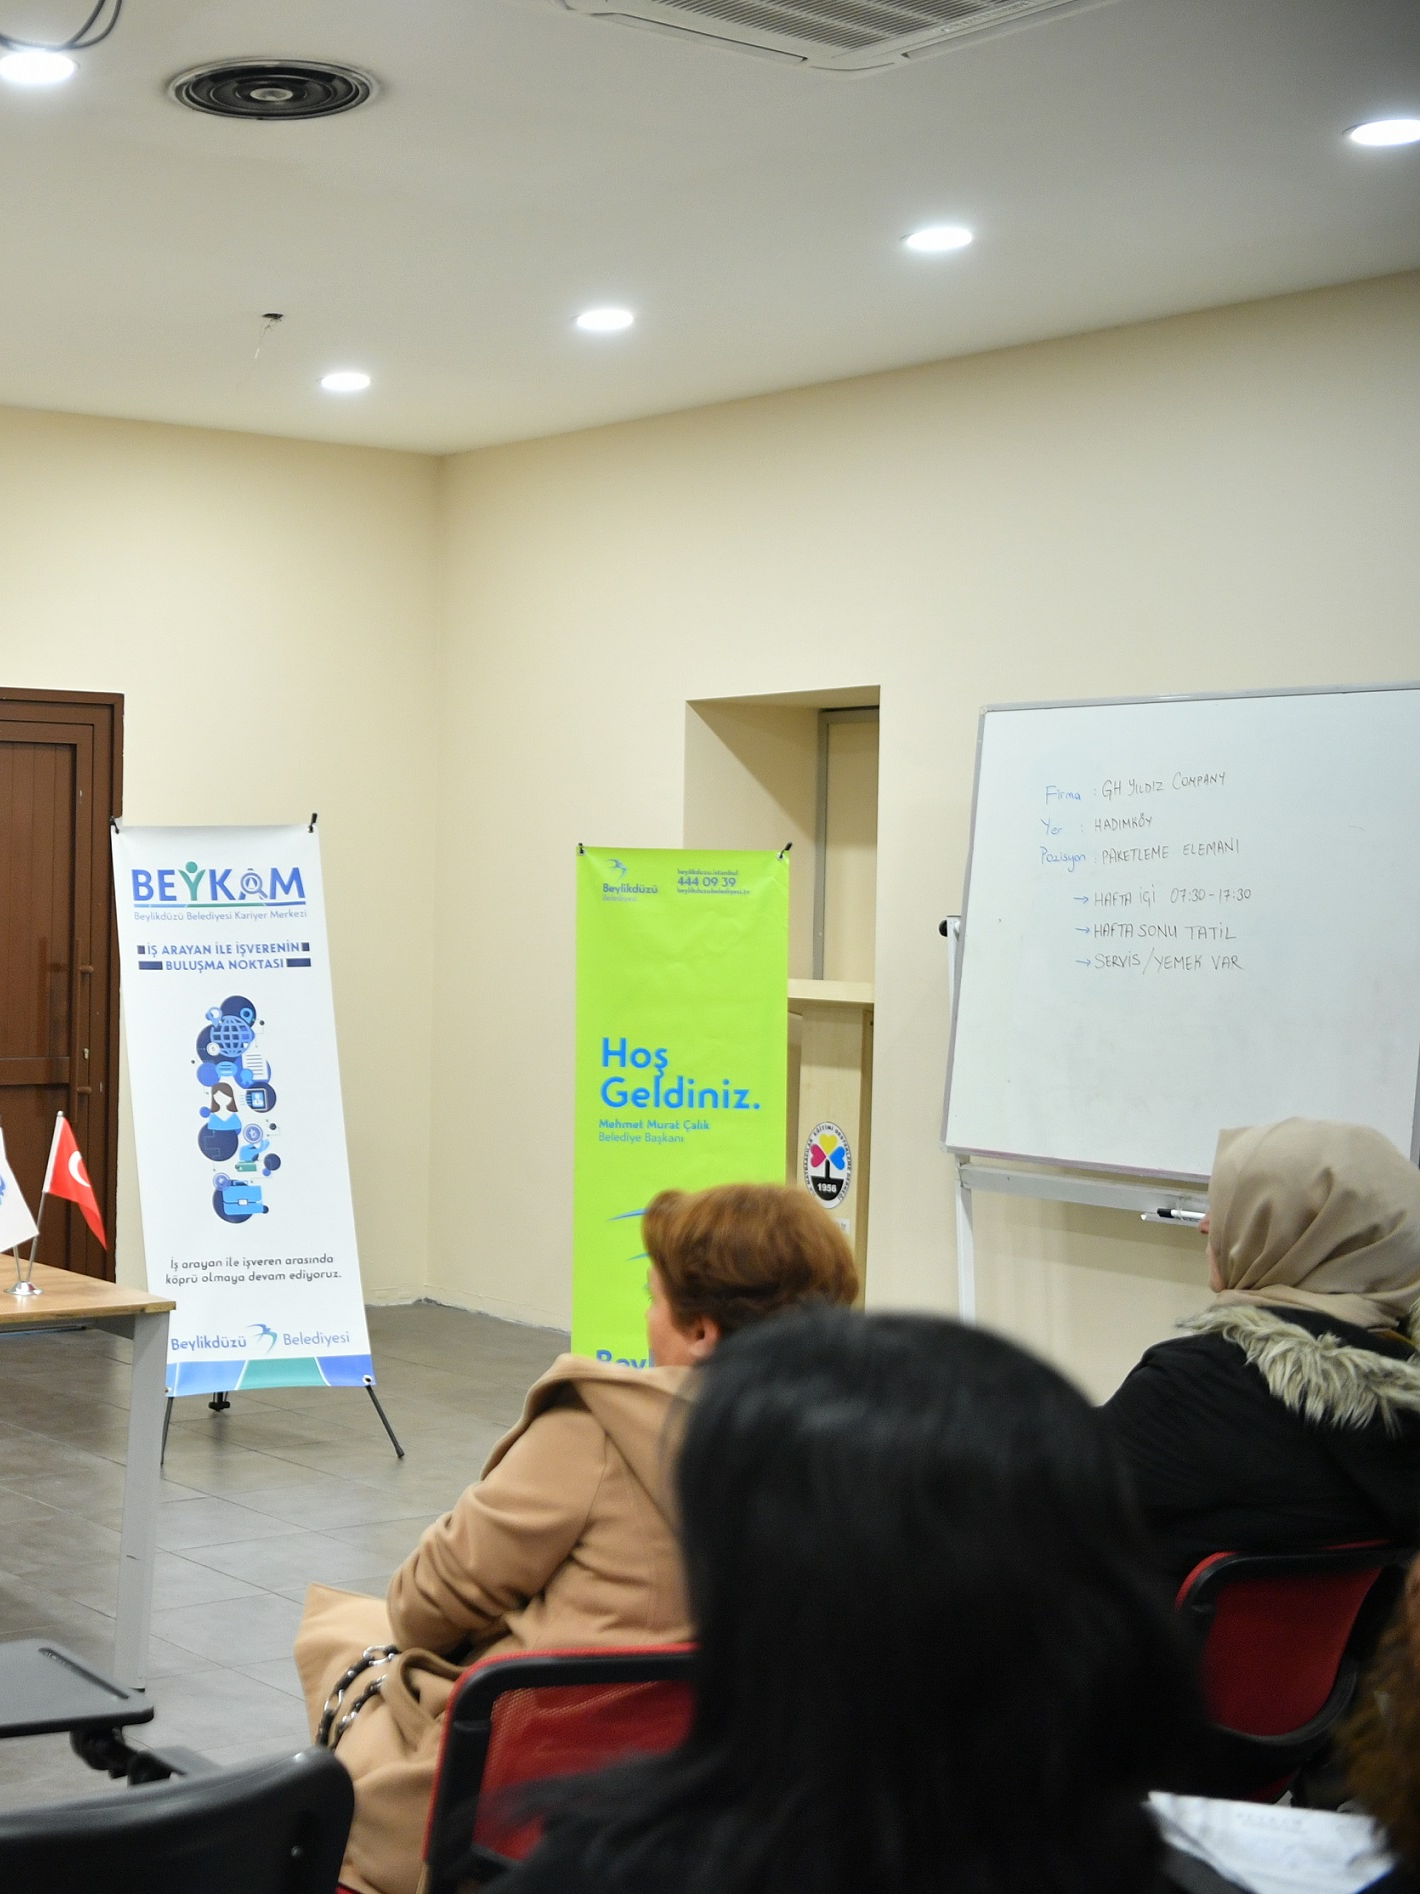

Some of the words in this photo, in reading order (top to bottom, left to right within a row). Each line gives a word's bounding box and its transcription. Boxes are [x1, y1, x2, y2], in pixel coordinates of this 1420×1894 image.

[1102, 845, 1169, 864] PAKETLEME
[602, 883, 658, 895] Beylikdüzü
[677, 876, 699, 887] 444
[702, 876, 718, 887] 09
[722, 877, 736, 887] 39
[1094, 891, 1132, 907] HAFTA
[134, 910, 184, 921] Beylikdüzü
[187, 910, 232, 921] Belediyesi
[234, 910, 268, 921] Kariyer
[270, 909, 307, 919] Merkezi
[1094, 922, 1133, 938] HAFTA
[1137, 923, 1177, 938] SONU
[1184, 922, 1237, 940] TATİL
[147, 943, 158, 957] İŞ
[162, 944, 212, 955] ARAYAN
[215, 941, 232, 954] İLE
[236, 940, 300, 956] İŞVERENİN
[165, 960, 224, 973] BULUŞMA
[228, 958, 284, 970] NOKTASI
[1212, 955, 1245, 970] VAR
[601, 1037, 669, 1078] Hoş
[600, 1075, 761, 1110] Geldiniz.
[599, 1119, 644, 1129] Mehmet
[647, 1120, 680, 1129] Murat
[599, 1131, 642, 1143] Belediye
[645, 1133, 684, 1145] Başkanı
[170, 1256, 179, 1270] İş
[182, 1260, 223, 1272] arayan
[226, 1257, 239, 1267] ile
[243, 1257, 282, 1269] işveren
[285, 1253, 334, 1265] arasında
[165, 1273, 198, 1286] köprü
[202, 1272, 245, 1285] olmaya
[248, 1271, 285, 1282] devam
[289, 1270, 342, 1282] ediyoruz.
[170, 1335, 247, 1352] Beylikdüzü
[283, 1331, 350, 1346] Belediyesi
